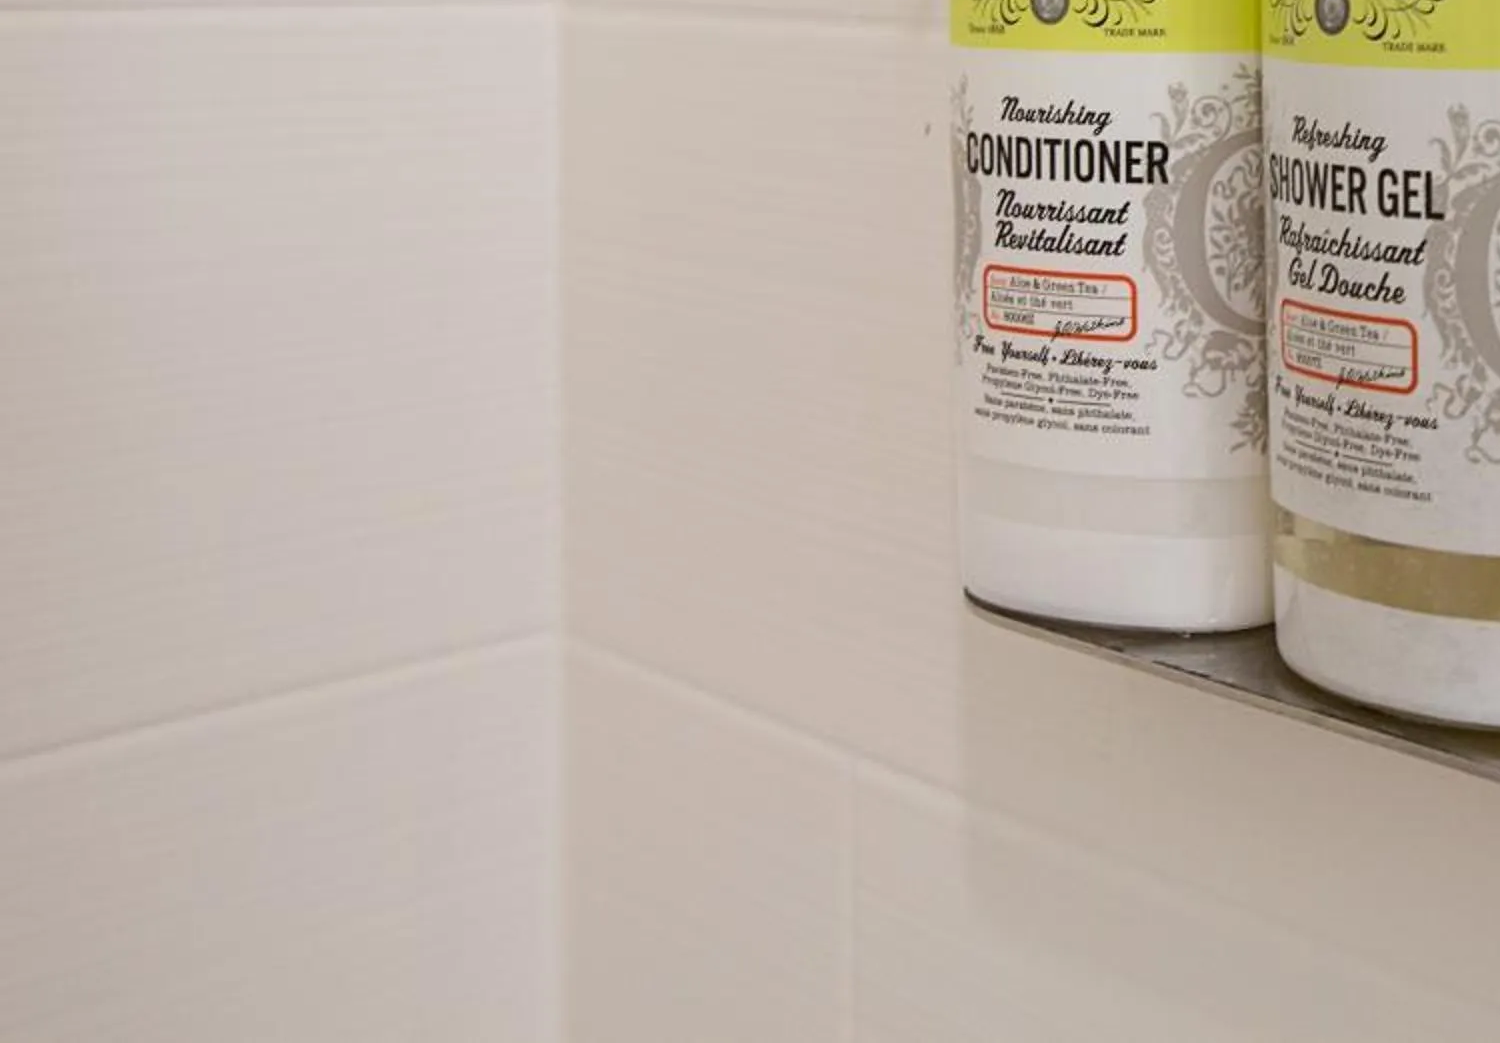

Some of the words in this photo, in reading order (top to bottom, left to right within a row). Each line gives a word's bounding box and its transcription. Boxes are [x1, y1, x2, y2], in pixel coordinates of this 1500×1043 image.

[1001, 96, 1112, 135] Nourishing
[1292, 114, 1388, 163] Refreshing
[967, 132, 1168, 184] CONDITIONER
[1270, 153, 1366, 215] SHOWER
[1378, 168, 1445, 220] GEL
[995, 188, 1130, 225] Nourrissant
[994, 220, 1128, 256] Revitalisant
[1033, 279, 1040, 289] &
[1042, 280, 1074, 292] Green
[1079, 283, 1098, 294] Tea
[1289, 257, 1316, 289] Gel
[1318, 262, 1406, 304] Douche
[1328, 319, 1357, 337] Green
[1360, 325, 1379, 339] Tea
[974, 334, 994, 355] Free
[1001, 341, 1050, 365] Yourself
